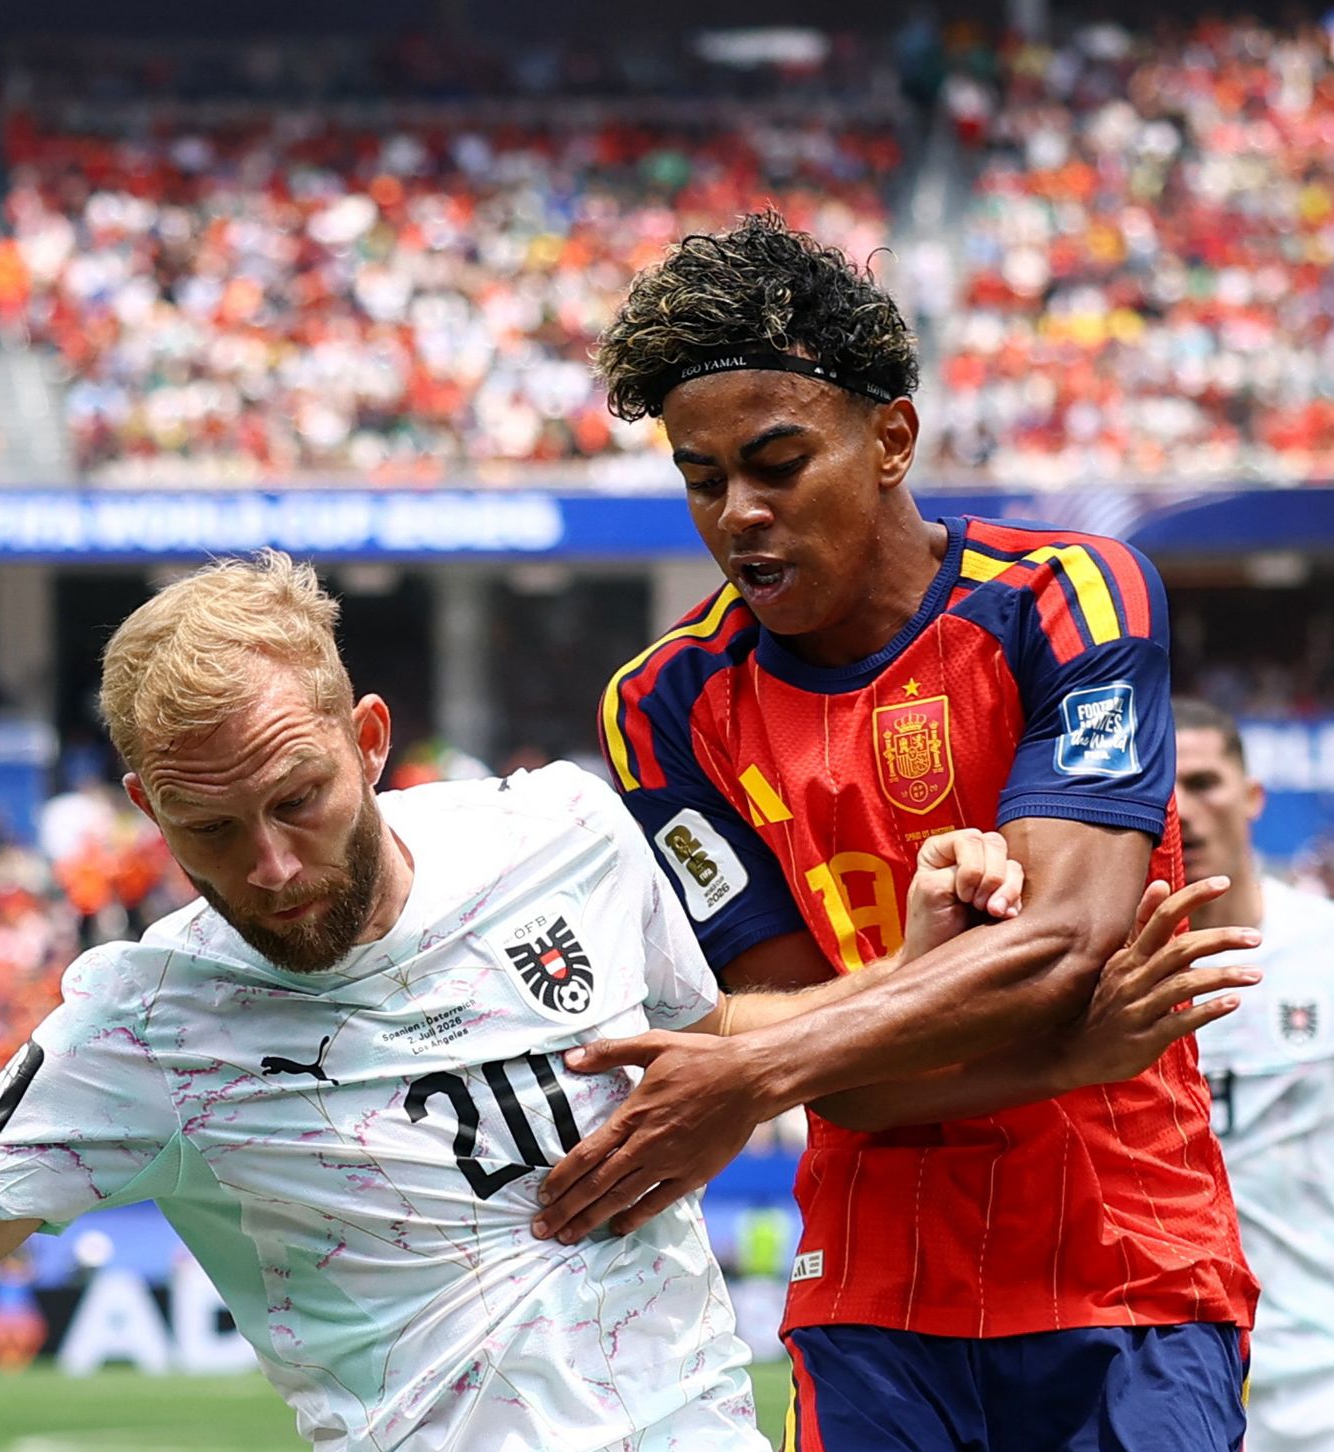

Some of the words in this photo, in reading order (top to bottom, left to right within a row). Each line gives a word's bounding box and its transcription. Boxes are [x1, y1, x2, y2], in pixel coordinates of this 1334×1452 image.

[703, 356, 747, 371] YAMAL
[707, 882, 730, 907] 2026
[381, 1023, 421, 1043] Spanien
[436, 1016, 463, 1034] 2026
[430, 1027, 470, 1046] Angeles
